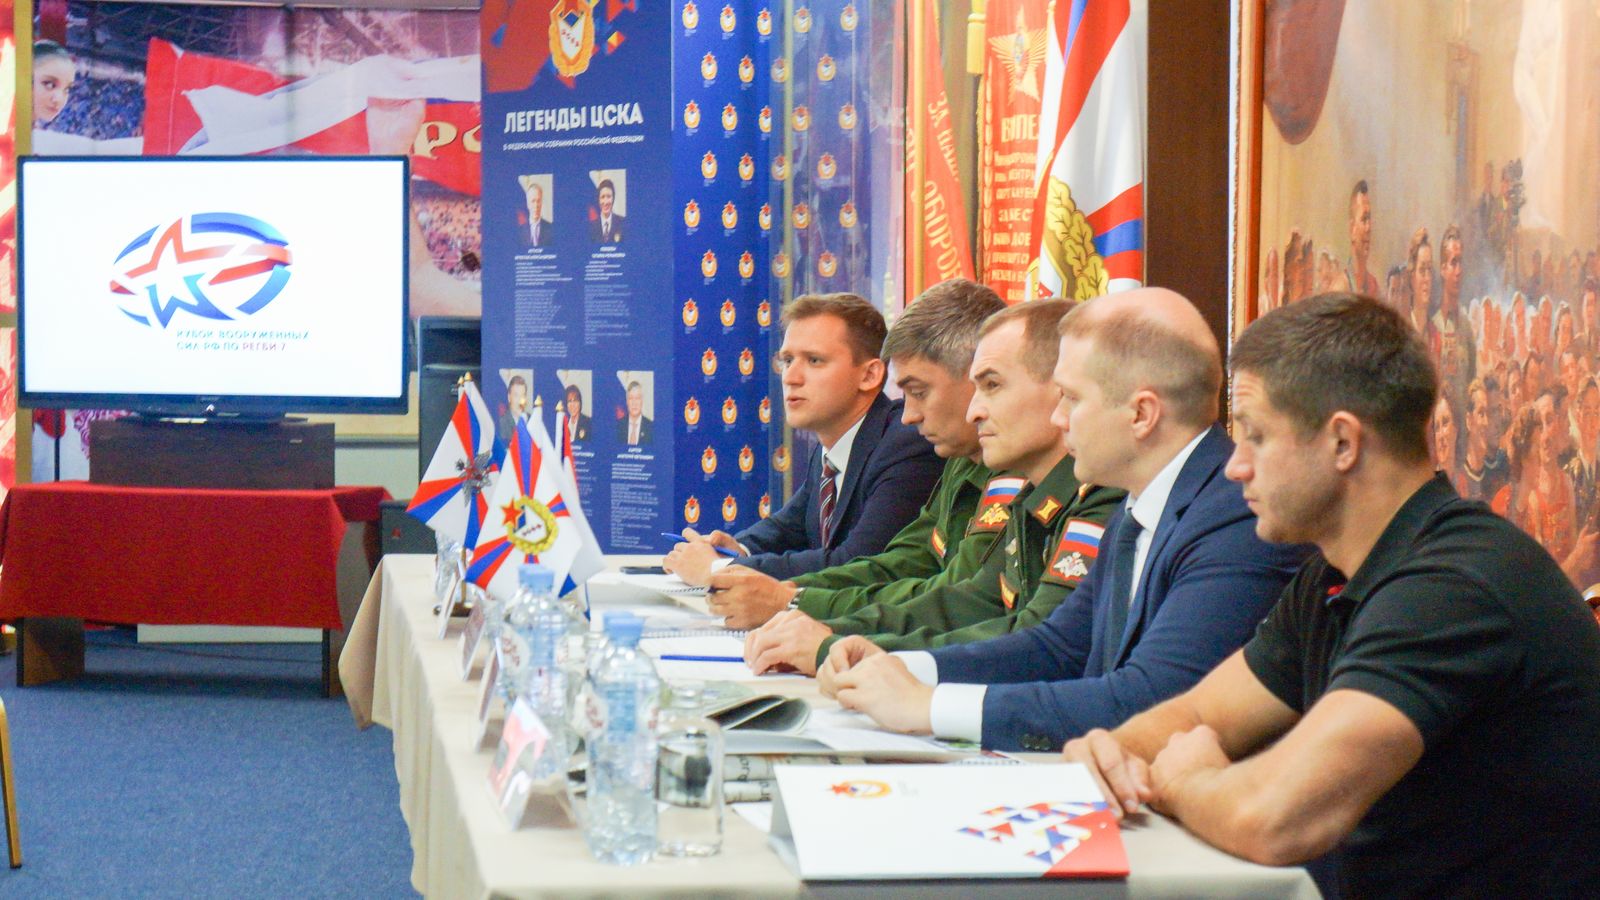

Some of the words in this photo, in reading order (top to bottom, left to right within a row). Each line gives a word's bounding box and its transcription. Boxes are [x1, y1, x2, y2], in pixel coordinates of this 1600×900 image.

[504, 106, 586, 134] ЛЕГЕНДЫ
[591, 102, 644, 129] ЦСКА
[223, 342, 239, 351] ПО
